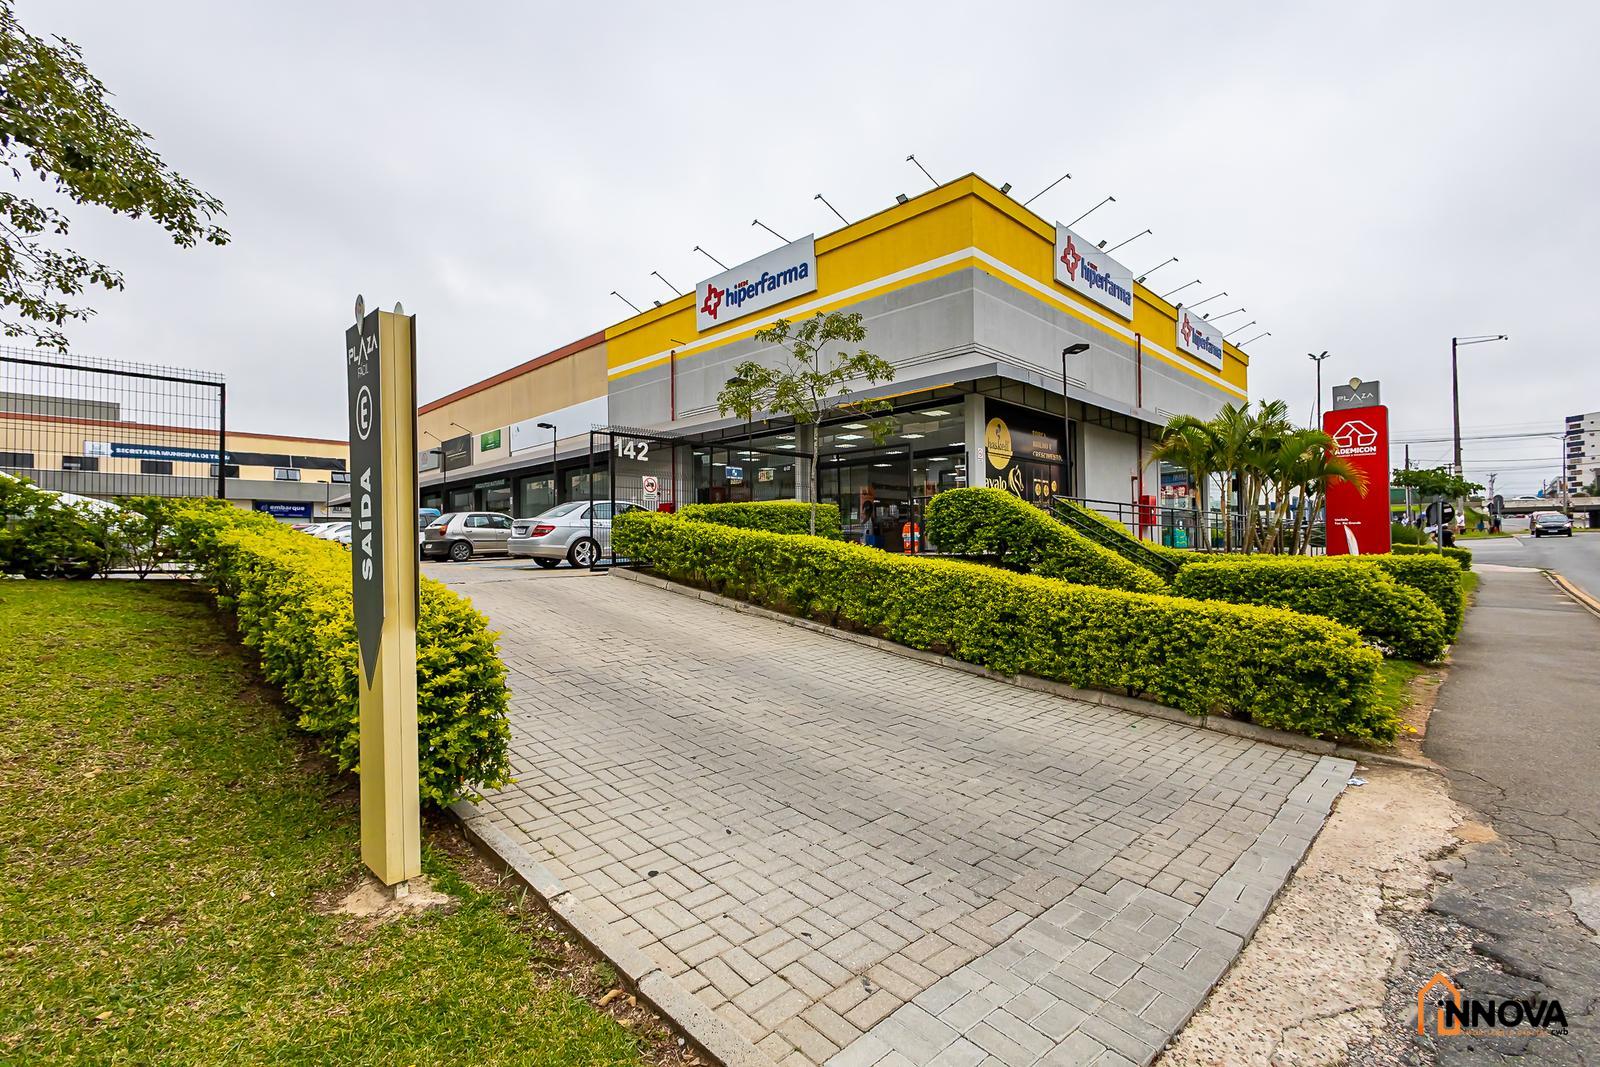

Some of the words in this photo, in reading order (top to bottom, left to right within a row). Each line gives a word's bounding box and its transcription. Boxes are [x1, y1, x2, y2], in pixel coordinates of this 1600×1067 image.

[725, 261, 809, 308] hiperfarma
[1080, 256, 1132, 307] hiperfarma
[347, 332, 378, 366] PLAZA
[1336, 392, 1374, 402] PLAZA
[613, 437, 649, 462] 142
[1334, 446, 1377, 455] ADEMICON
[984, 475, 1007, 491] avalo
[269, 504, 305, 512] embarque
[358, 466, 374, 581] SAÍDA
